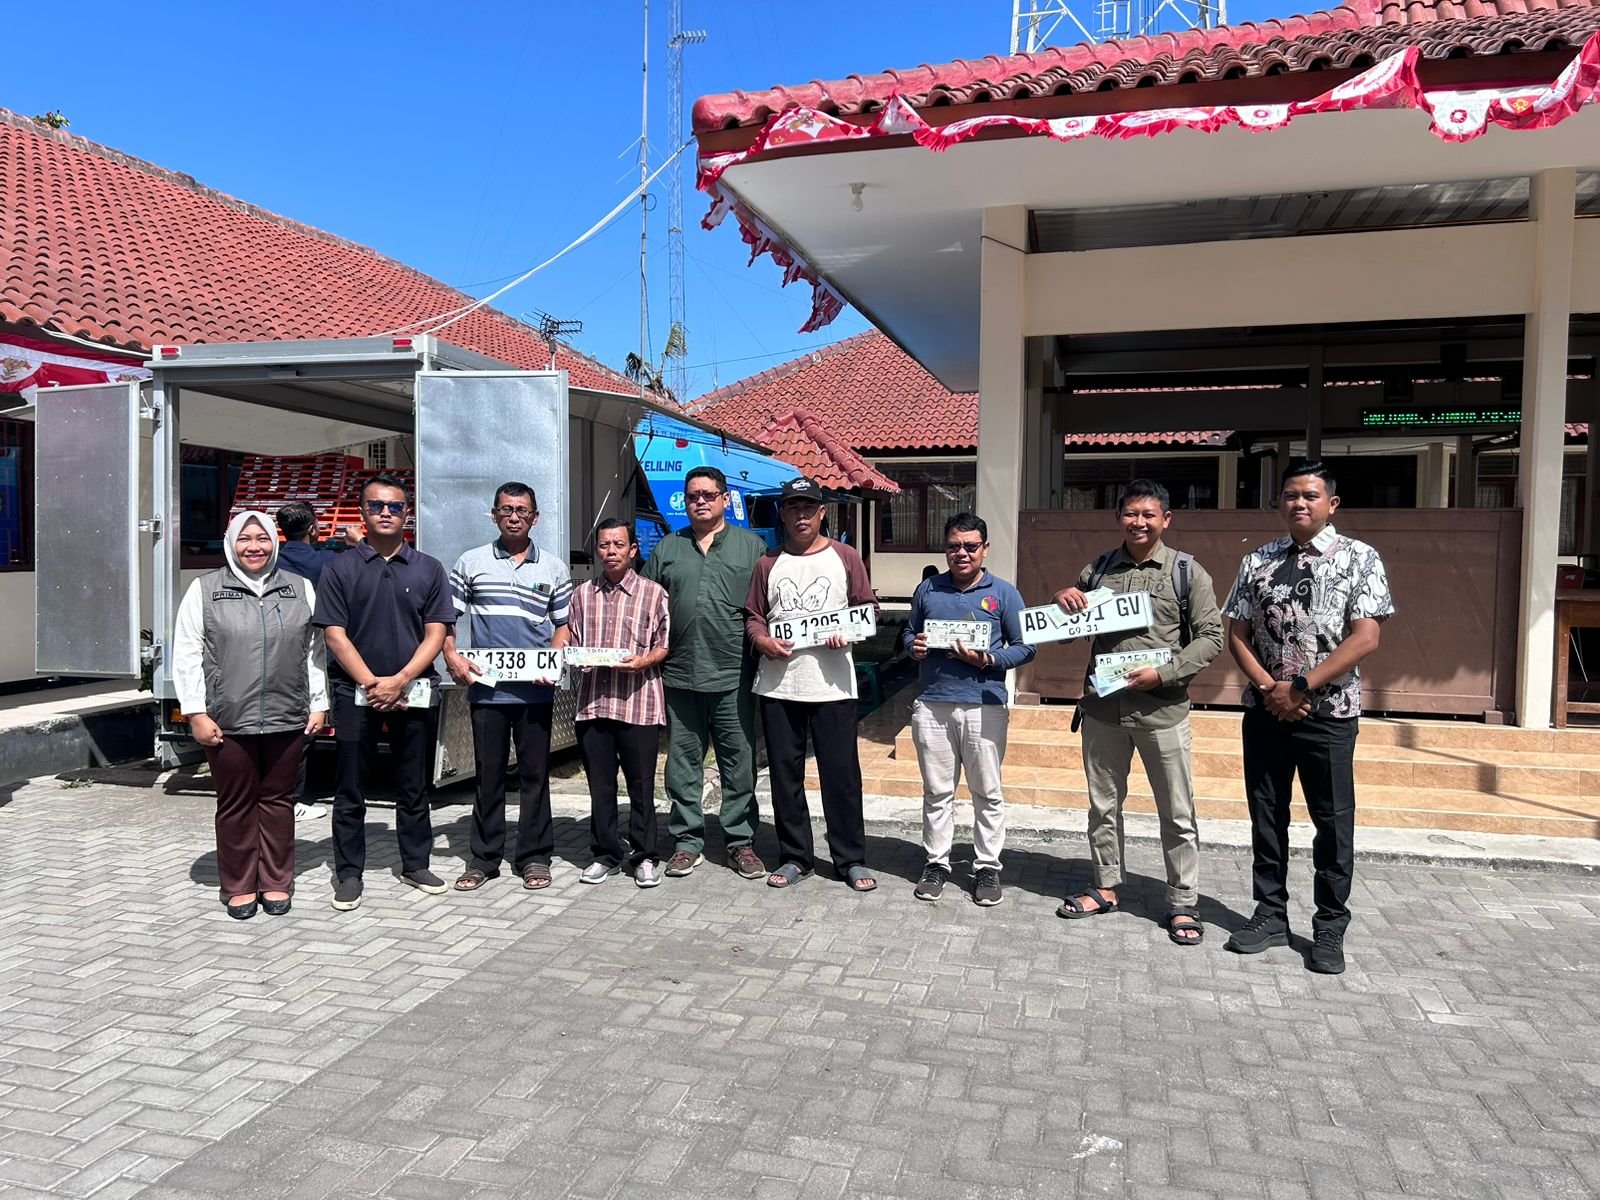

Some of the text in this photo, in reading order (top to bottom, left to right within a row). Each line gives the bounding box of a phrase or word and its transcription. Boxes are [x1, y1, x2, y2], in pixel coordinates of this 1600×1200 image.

[641, 461, 682, 472] ELILING
[1024, 610, 1047, 632] AB
[1116, 595, 1140, 617] GV
[775, 622, 793, 640] AB
[485, 651, 526, 669] 1338
[537, 651, 558, 669] CK
